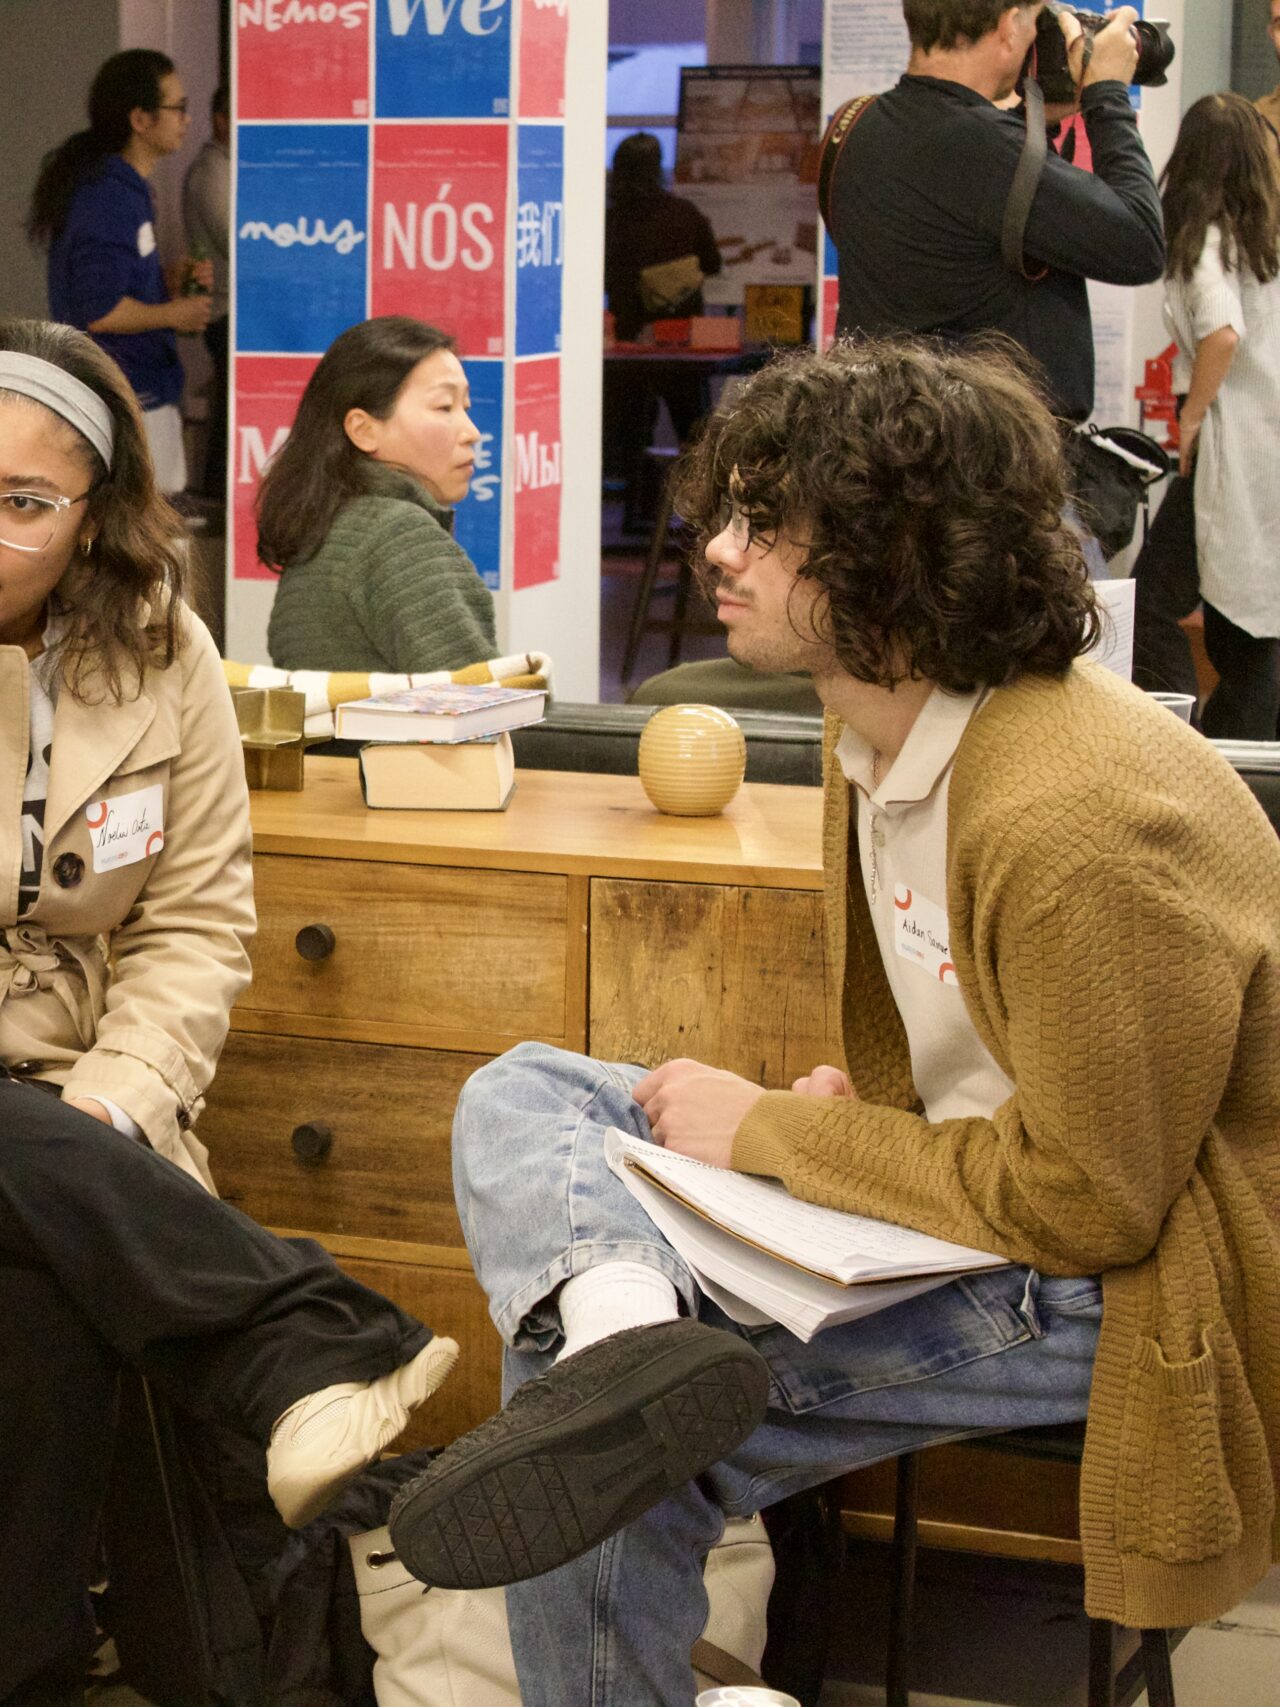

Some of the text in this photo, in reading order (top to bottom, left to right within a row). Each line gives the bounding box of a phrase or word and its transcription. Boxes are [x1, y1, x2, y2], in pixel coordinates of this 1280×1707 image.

[831, 95, 872, 144] Canon
[239, 216, 365, 254] nous
[383, 183, 495, 271] NÓS
